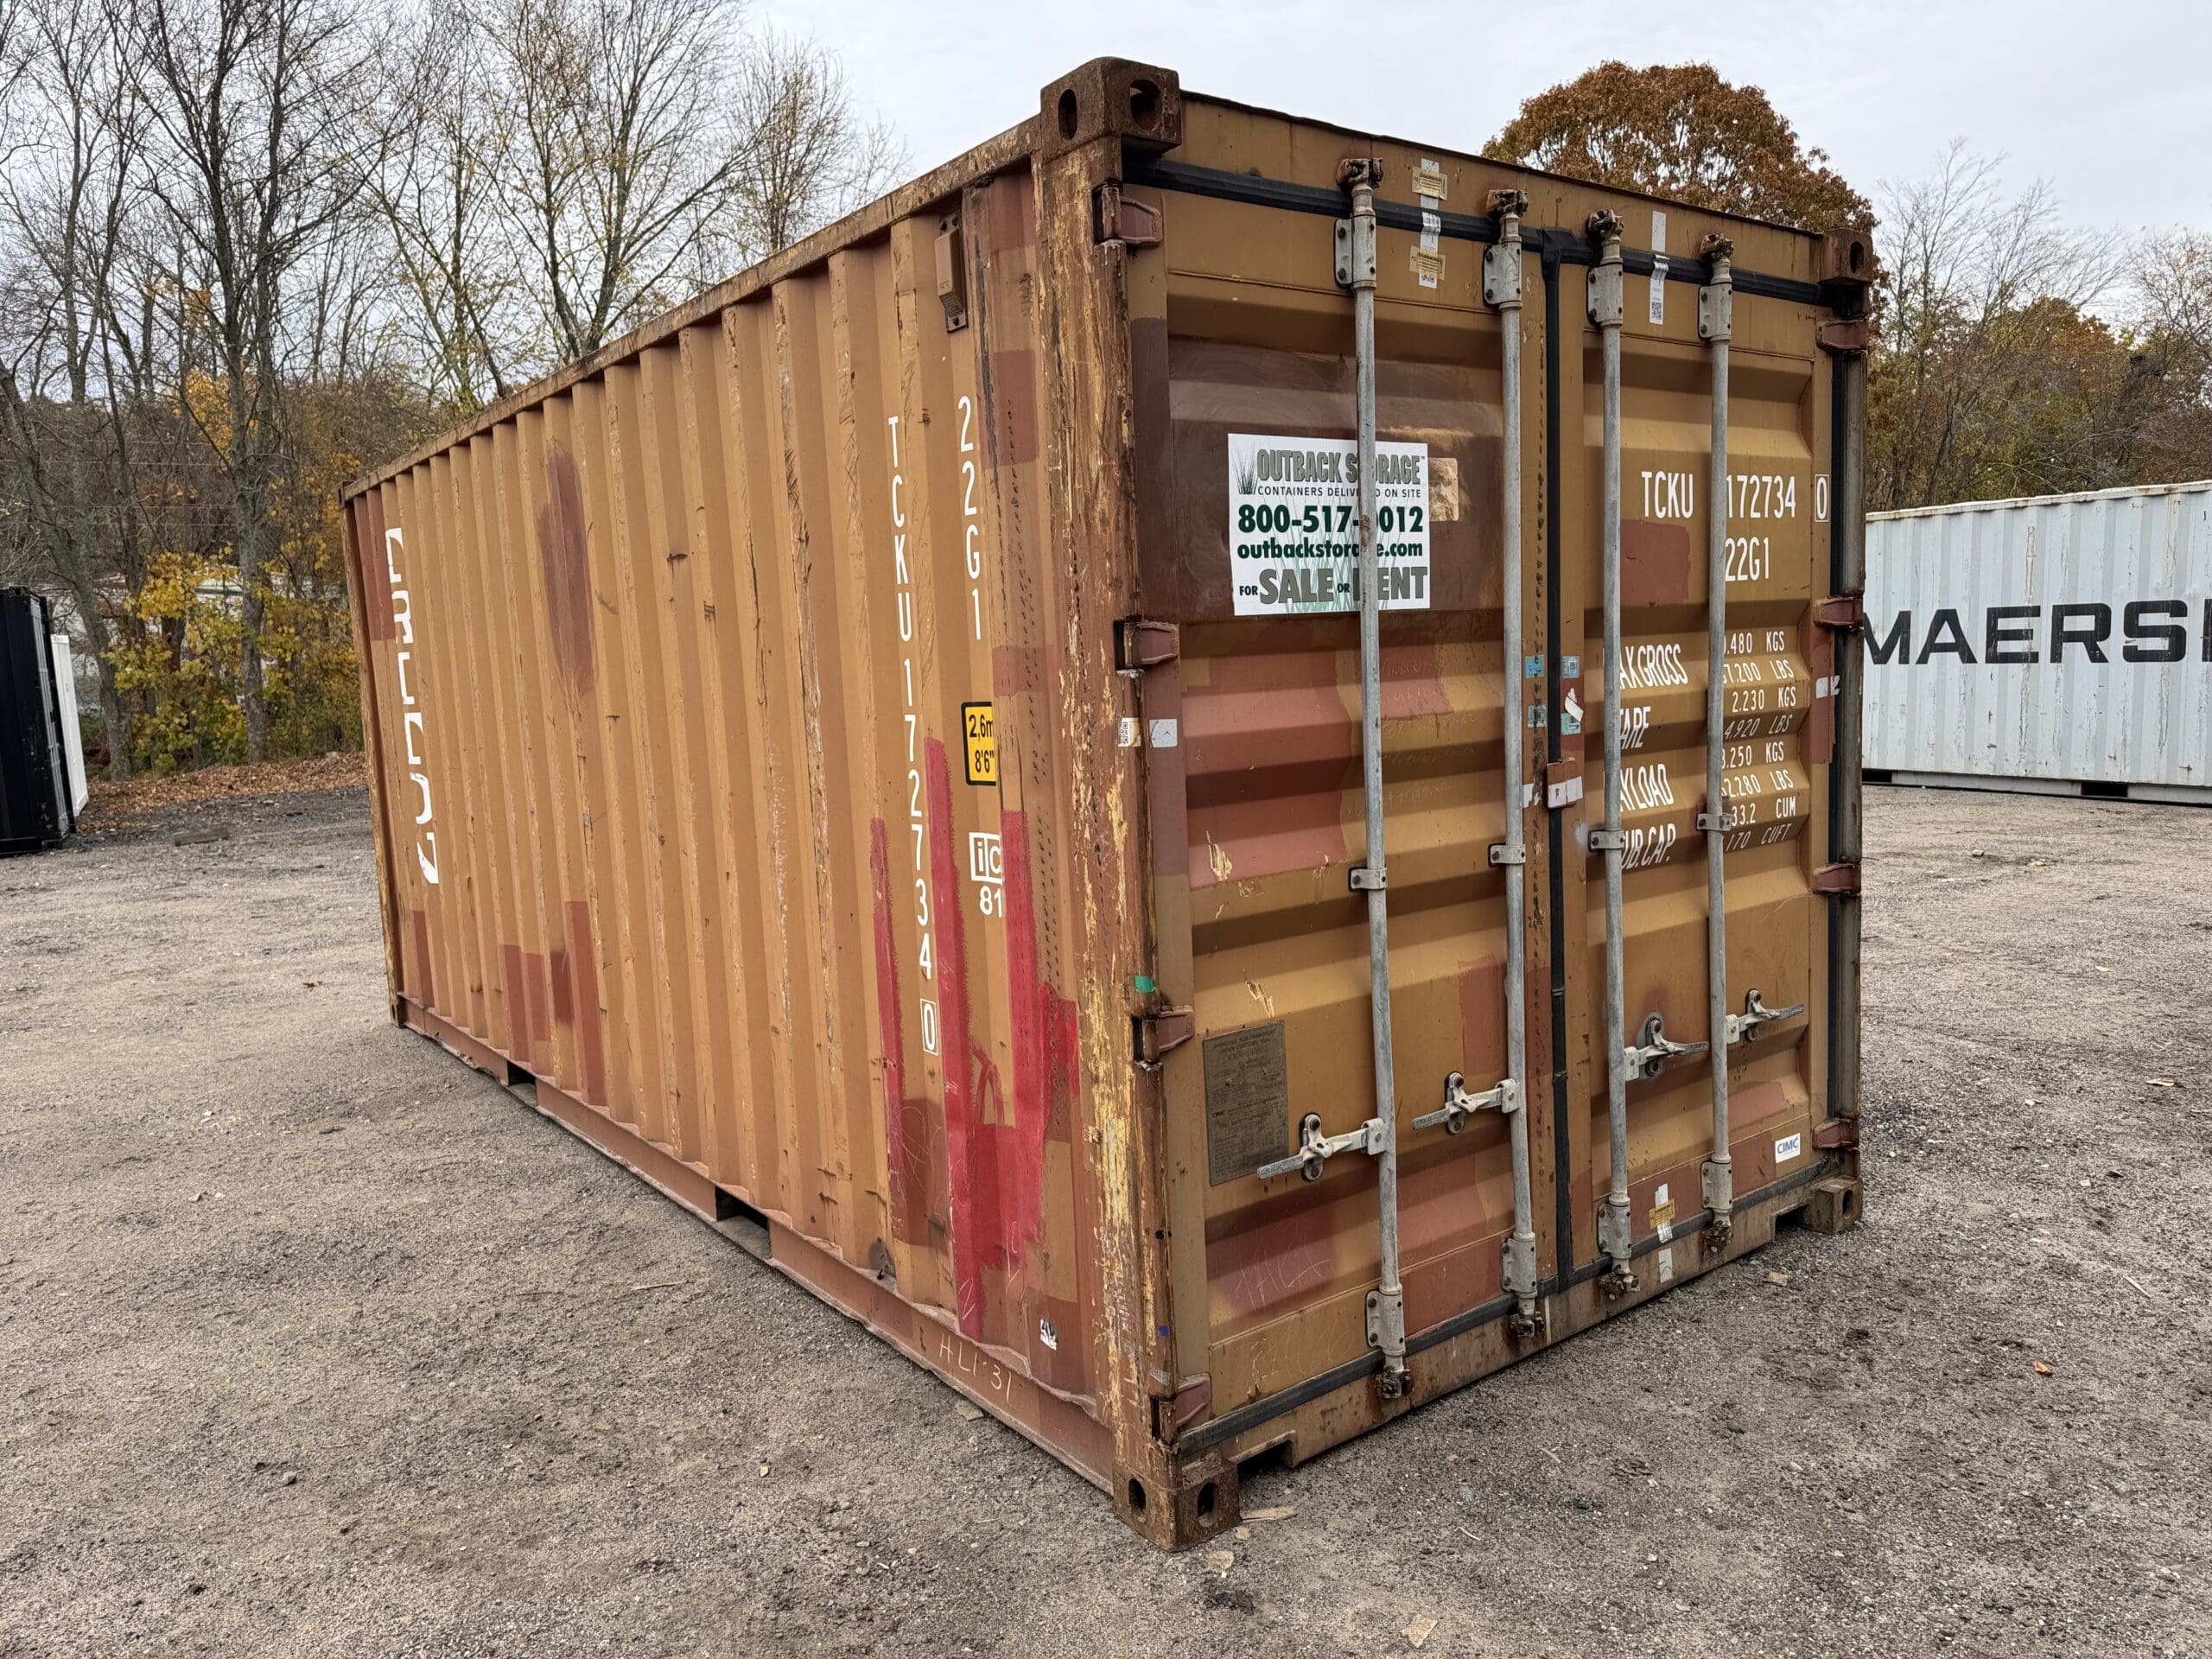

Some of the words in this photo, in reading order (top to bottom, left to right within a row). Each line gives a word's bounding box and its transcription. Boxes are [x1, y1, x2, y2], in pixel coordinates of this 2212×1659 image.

[1256, 448, 1343, 483] OUTBACK
[1345, 452, 1421, 485] SRAGE
[1258, 486, 1323, 498] CONTAINERS
[1327, 486, 1381, 499] DELIVD
[1384, 488, 1398, 498] ON
[1402, 488, 1421, 499] SITE
[1642, 471, 1694, 518] TCKU
[1726, 474, 1796, 518] 172734
[1816, 476, 1828, 520] 0
[958, 395, 982, 640] 22G1
[1238, 504, 1423, 533] 800-517-012
[1237, 537, 1423, 559] outbackstorae.com
[1725, 537, 1770, 582] 22G1
[1239, 586, 1259, 596] FOR
[1259, 569, 1334, 605] SALE
[1337, 582, 1350, 594] OR
[1766, 631, 1785, 652] KGS
[1864, 599, 2212, 665] MAERS
[1637, 643, 1688, 687] GROSS
[1723, 661, 1762, 683] 7.200
[1770, 659, 1794, 680] LBS
[1732, 689, 1764, 713] 2.230
[1778, 686, 1796, 709] KGS
[1768, 714, 1793, 734] LBS
[1766, 741, 1784, 764] KGS
[1770, 769, 1794, 791] LBS
[1731, 803, 1757, 827] 33.2
[1776, 796, 1796, 819] CUM
[979, 886, 1003, 918] 81
[1777, 1136, 1798, 1154] CIMC
